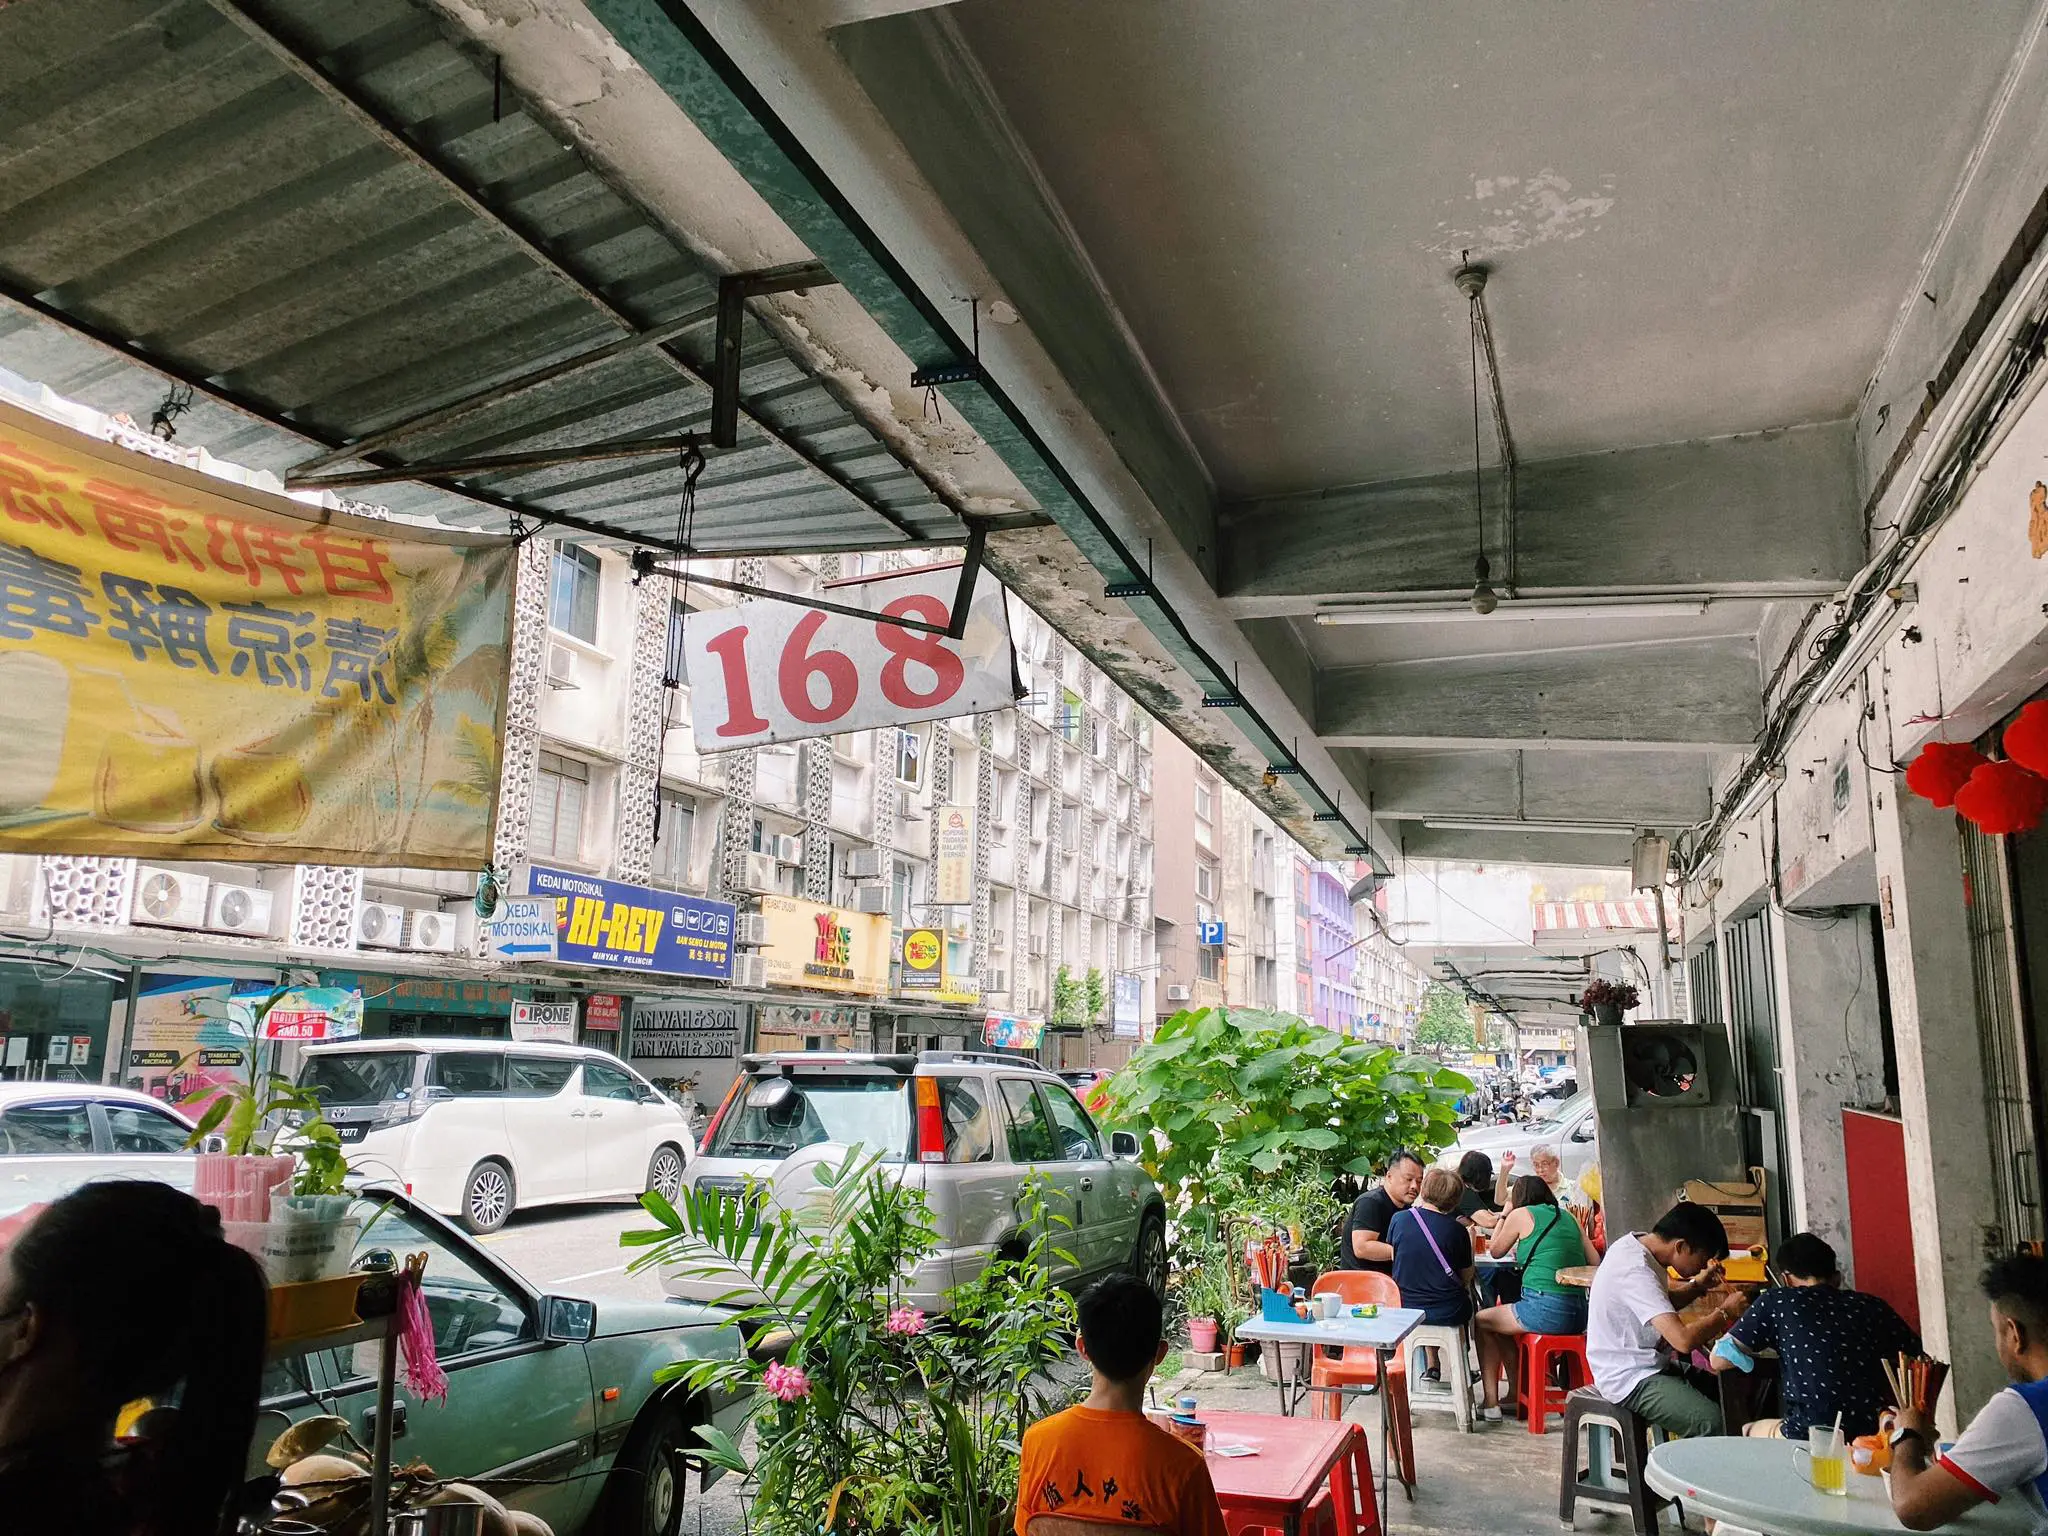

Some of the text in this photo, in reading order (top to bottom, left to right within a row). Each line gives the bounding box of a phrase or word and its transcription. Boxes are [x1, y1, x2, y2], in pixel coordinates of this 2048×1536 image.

[706, 594, 965, 737] 168
[537, 873, 604, 898] KEDAI MOTOSIKAL
[507, 903, 539, 918] KEDAI
[492, 922, 555, 937] MOTOSIKAL
[567, 896, 665, 955] HI-REV
[1205, 923, 1219, 943] P
[688, 937, 703, 947] SENG
[709, 940, 728, 950] MOTOR
[815, 936, 850, 965] HENG
[592, 951, 653, 966] MINYAK PELINCIR
[528, 1006, 571, 1022] IPONE
[658, 1011, 691, 1029] WAH
[694, 1010, 706, 1028] &
[705, 1009, 737, 1029] SON
[659, 1041, 690, 1057] WAH
[692, 1040, 703, 1056] &
[704, 1039, 734, 1057] SON
[341, 1128, 358, 1137] 7077
